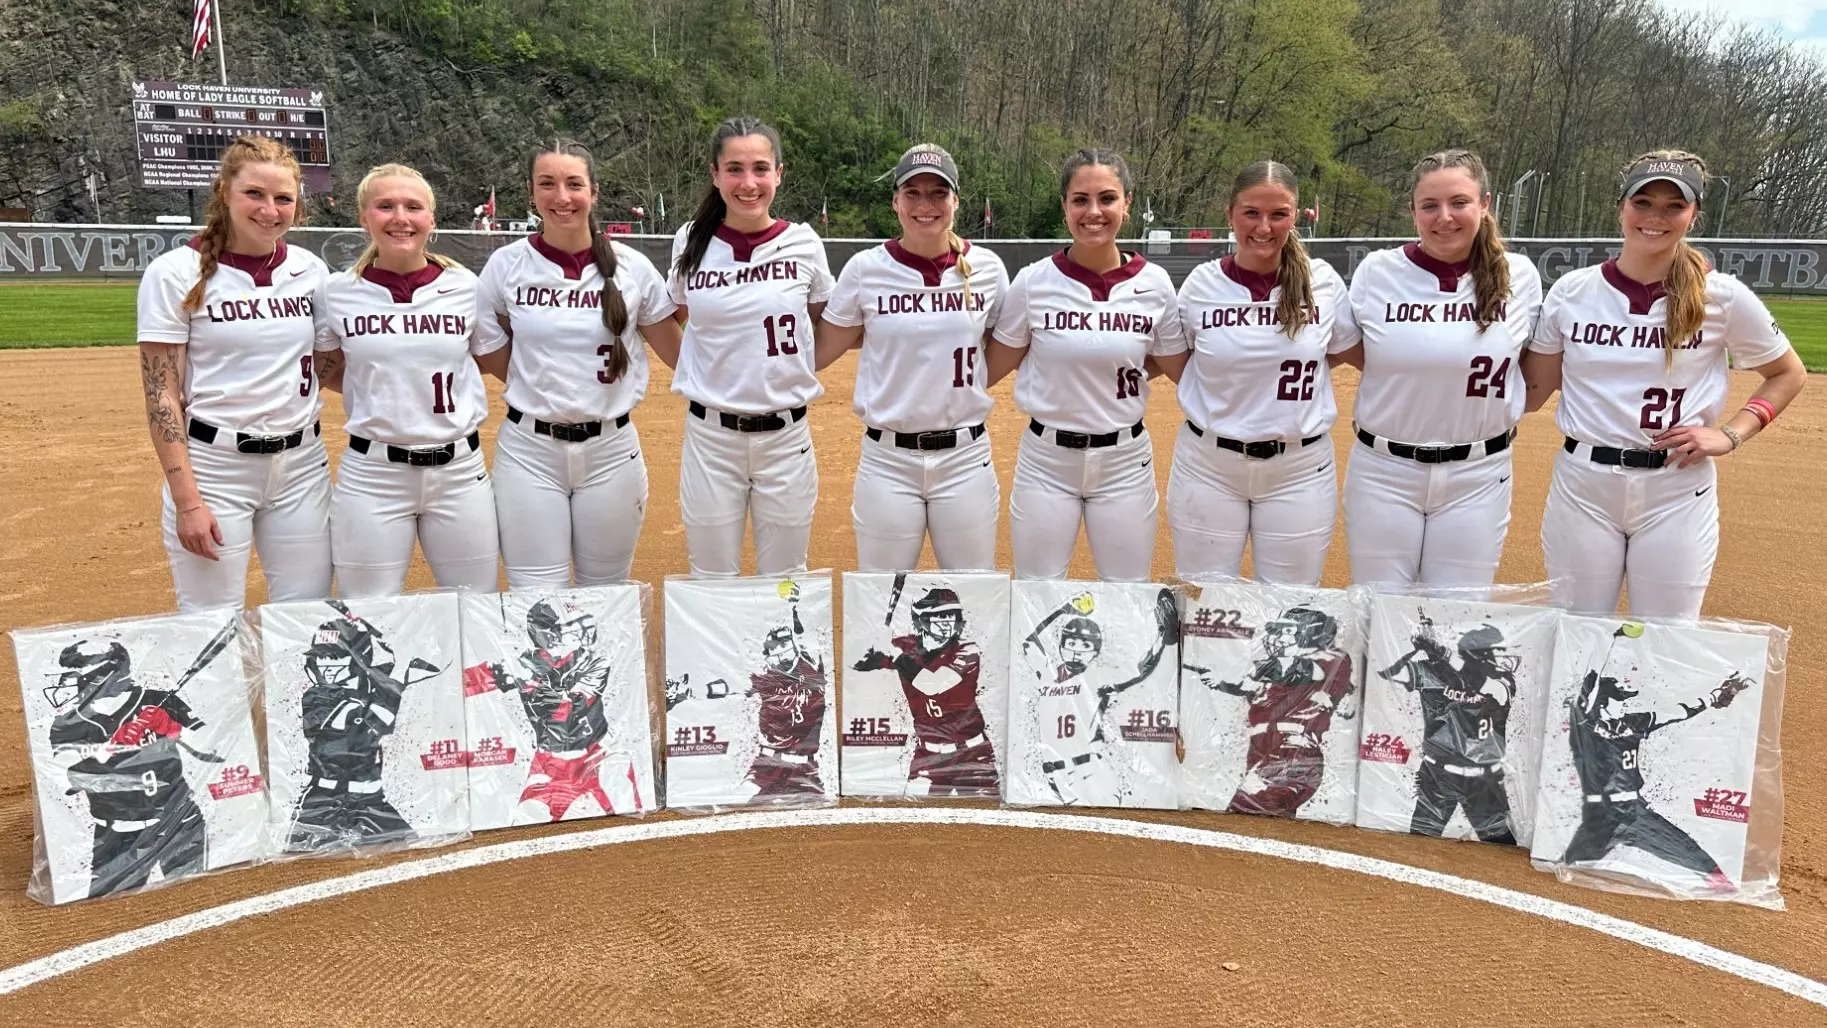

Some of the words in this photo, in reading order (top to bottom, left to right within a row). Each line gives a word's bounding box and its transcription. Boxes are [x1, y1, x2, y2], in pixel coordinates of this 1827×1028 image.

[152, 90, 181, 100] HOME
[183, 92, 196, 101] OF
[198, 92, 223, 102] LADY
[226, 94, 257, 104] EAGLE
[258, 95, 306, 106] SOFTBALL
[232, 87, 280, 95] UNIVERSITY
[137, 111, 154, 120] BAT
[140, 103, 151, 111] AT
[178, 108, 201, 118] BALL
[214, 110, 246, 120] STRIKE
[258, 112, 276, 121] OUT
[290, 114, 304, 122] H/E
[143, 133, 183, 144] VISITOR
[154, 147, 176, 157] LHU
[912, 152, 942, 164] HAVEN
[1648, 162, 1684, 172] HAVEN
[687, 270, 732, 290] LOCK
[736, 261, 798, 285] HAVEN
[516, 286, 567, 308] LOCK
[878, 293, 926, 315] LOCK
[207, 299, 266, 322] LOCK
[1202, 307, 1251, 330] LOCK
[1257, 305, 1320, 326] HAN
[1385, 302, 1437, 323] LOCK
[1443, 302, 1507, 323] HAVN
[343, 314, 396, 338] LOCK
[402, 314, 466, 336] HAVEN
[1044, 312, 1093, 331] LOCK
[1099, 312, 1153, 335] HAVEN
[763, 313, 798, 357] 13
[1571, 322, 1627, 348] LOCK
[1631, 326, 1703, 350] HAN
[299, 355, 312, 397] 9
[952, 346, 978, 388] 15
[1116, 366, 1143, 400] 16
[1277, 359, 1318, 401] 22
[1466, 355, 1511, 399] 24
[431, 371, 456, 414] 11
[1639, 387, 1687, 430] 27
[1194, 608, 1242, 628] #22
[1049, 684, 1082, 697] HAVEN
[1443, 685, 1466, 702] LOCK
[925, 698, 943, 718] 15
[578, 715, 593, 736] 3
[850, 718, 891, 735] #15
[1056, 714, 1076, 739] 16
[1127, 709, 1171, 728] #16
[478, 736, 504, 752] #3
[674, 725, 717, 745] #13
[1366, 733, 1405, 752] #24
[427, 752, 463, 761] DELANEY
[430, 739, 458, 755] #11
[474, 749, 507, 757] MORGAN
[434, 759, 456, 767] GOOD
[473, 755, 508, 763] KARASEK
[141, 769, 158, 797] 9
[222, 764, 250, 783] #9
[1704, 788, 1747, 806] #27
[1701, 807, 1745, 819] WALTMAN
[1712, 802, 1735, 812] MADI
